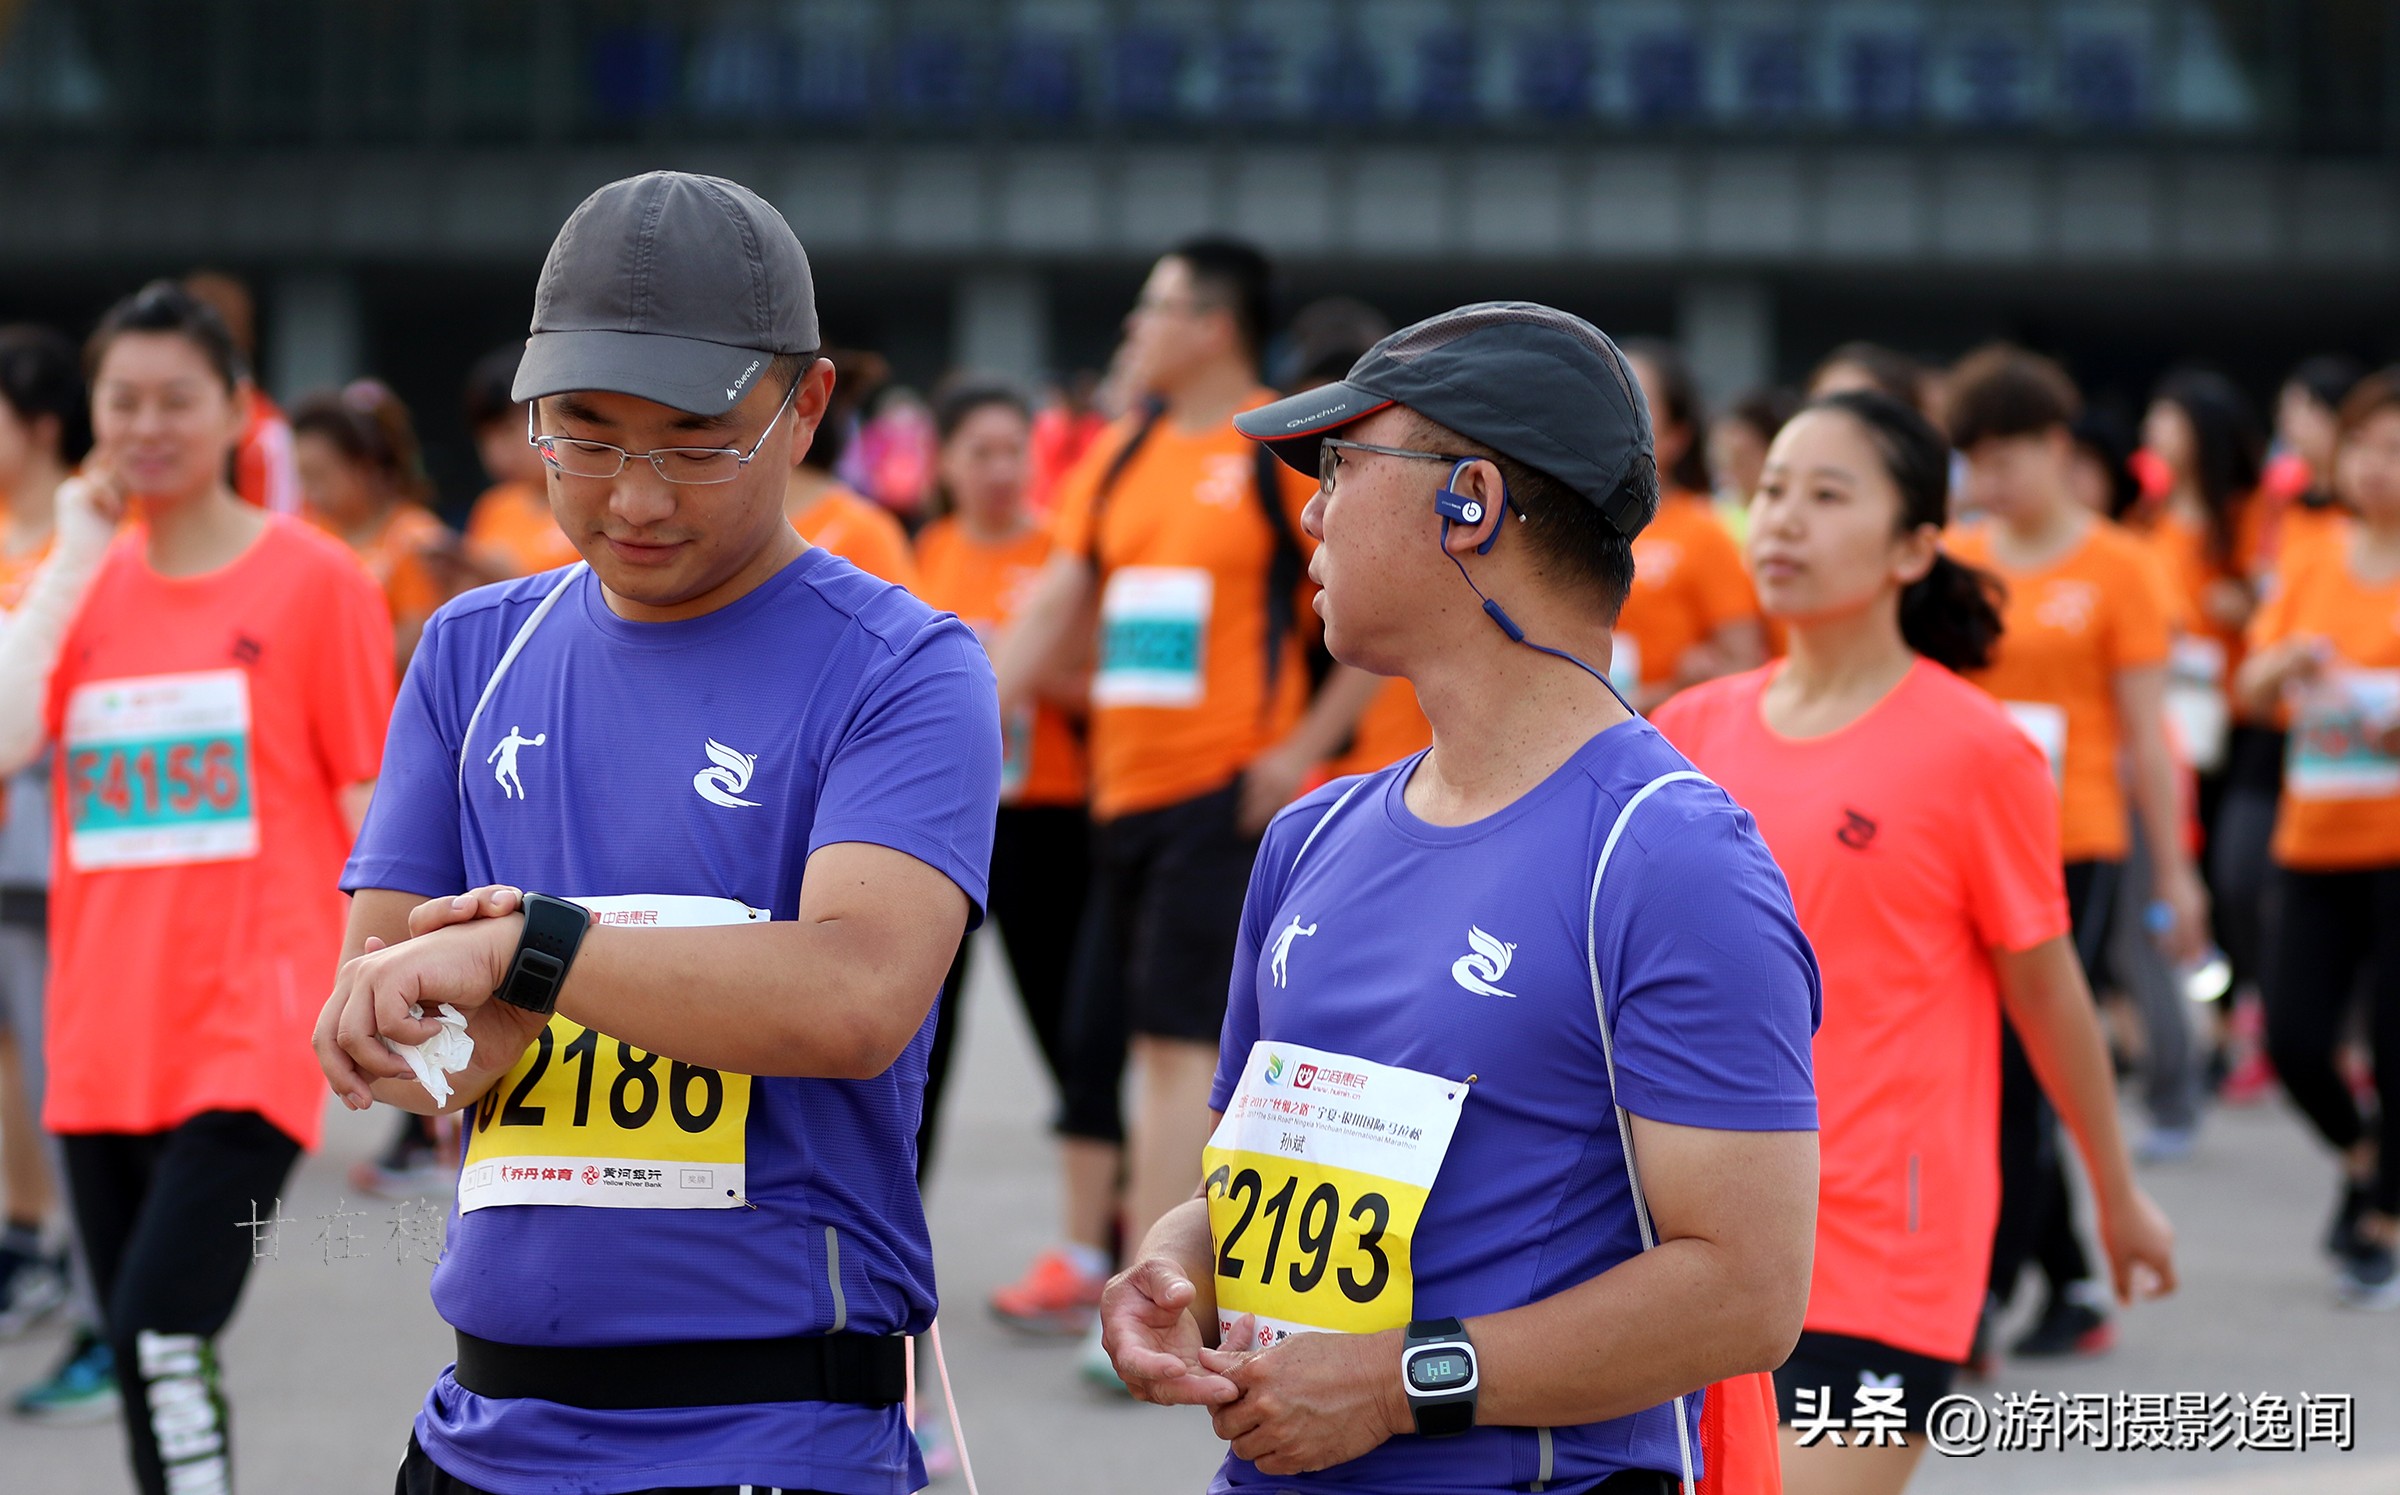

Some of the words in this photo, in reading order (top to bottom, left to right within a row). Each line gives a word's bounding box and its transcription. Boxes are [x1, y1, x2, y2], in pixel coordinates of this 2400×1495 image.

[734, 360, 760, 389] Quechua
[1286, 403, 1346, 428] Quechua
[602, 910, 658, 925] 中商惠民
[1317, 1068, 1368, 1089] 中商惠民
[1279, 1131, 1306, 1153] 孙斌
[603, 1179, 623, 1187] Yellow
[625, 1180, 643, 1188] River
[645, 1181, 662, 1189] Bank
